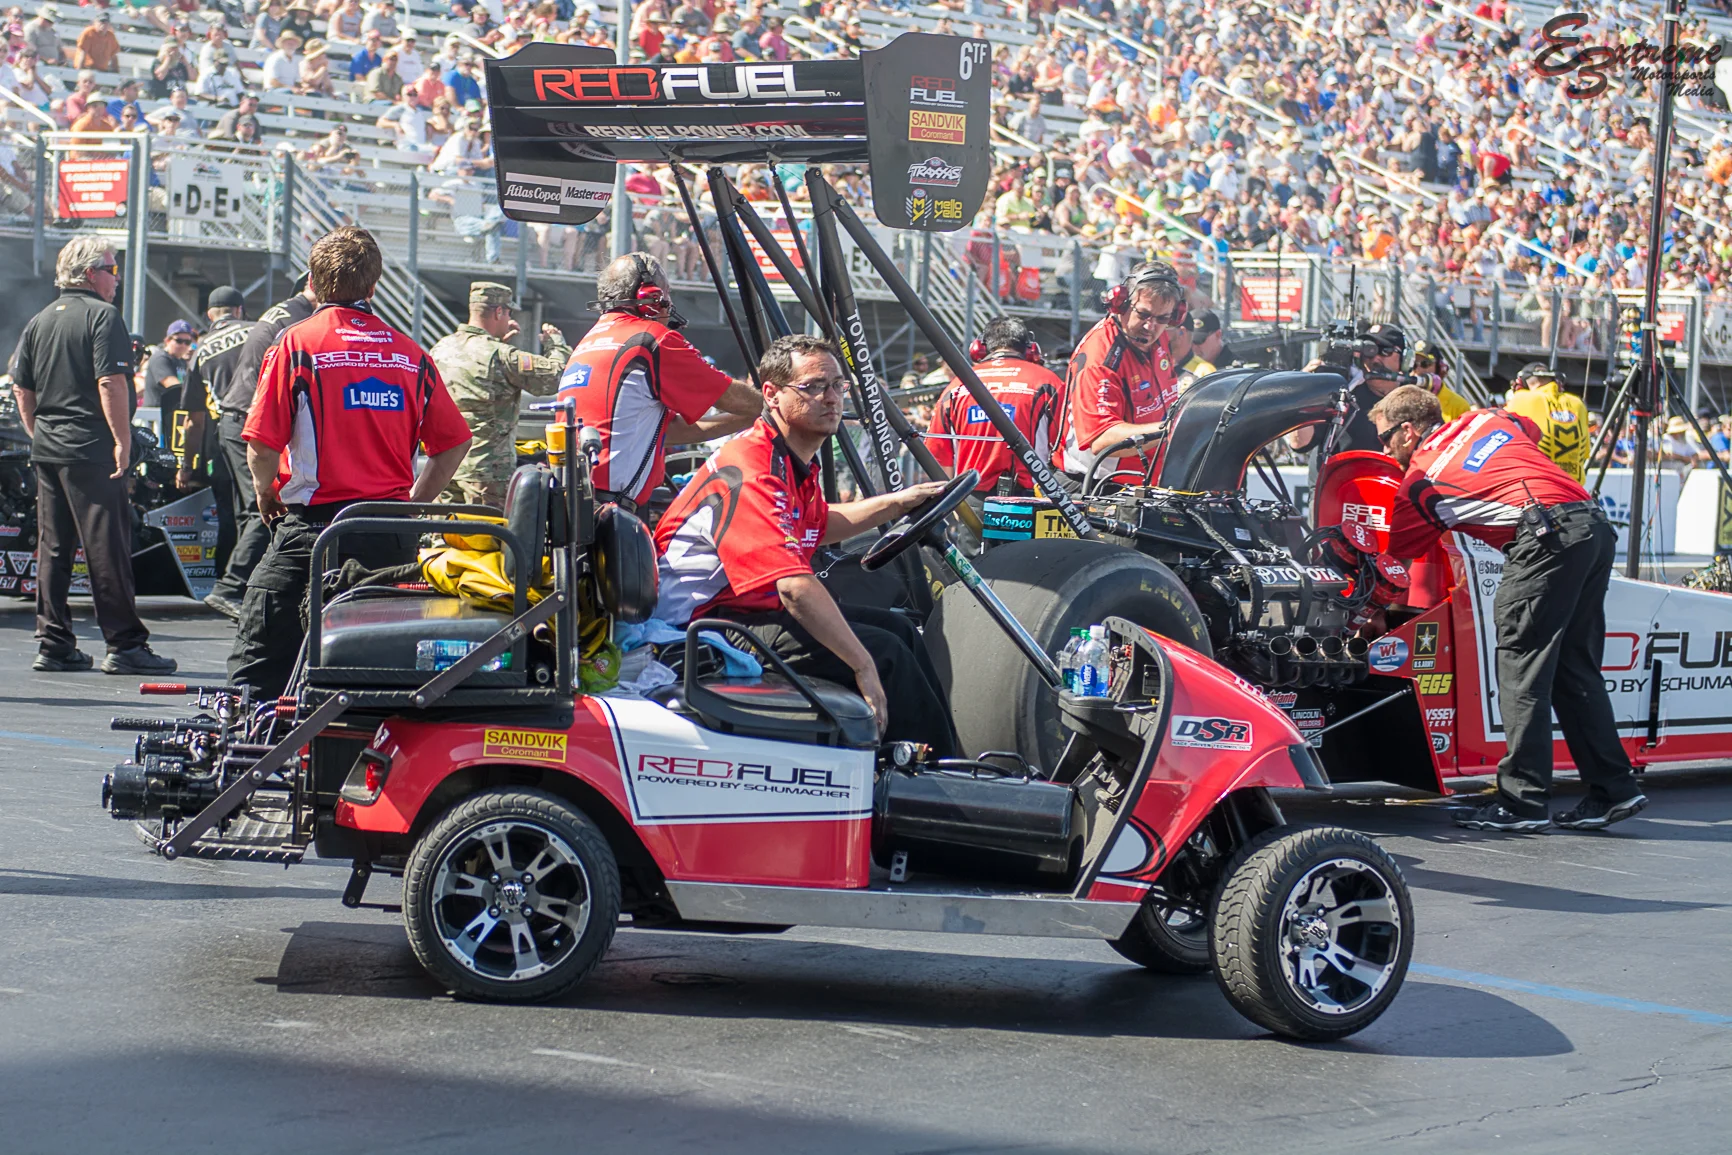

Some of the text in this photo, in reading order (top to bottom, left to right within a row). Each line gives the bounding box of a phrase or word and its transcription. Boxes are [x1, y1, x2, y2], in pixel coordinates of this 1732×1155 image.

[911, 75, 956, 90] RED
[910, 87, 964, 103] FUEL
[911, 111, 964, 130] SANDVIK
[920, 128, 954, 141] Coromant
[911, 165, 961, 180] TRAXXAS
[565, 185, 611, 202] Mastercam
[314, 362, 357, 370] POWERED
[1342, 503, 1387, 517] RED
[168, 515, 195, 526] ROCKY
[1355, 525, 1367, 547] MSD
[1273, 567, 1344, 581] TOOTA
[1385, 565, 1405, 576] MSD
[1620, 678, 1649, 693] BY
[1292, 711, 1319, 719] LINCOLN
[1176, 719, 1248, 742] DSR
[487, 730, 564, 749] SANDVIK
[501, 746, 549, 759] Coromant
[637, 774, 850, 799] POWERED BY SCHUMACHER
